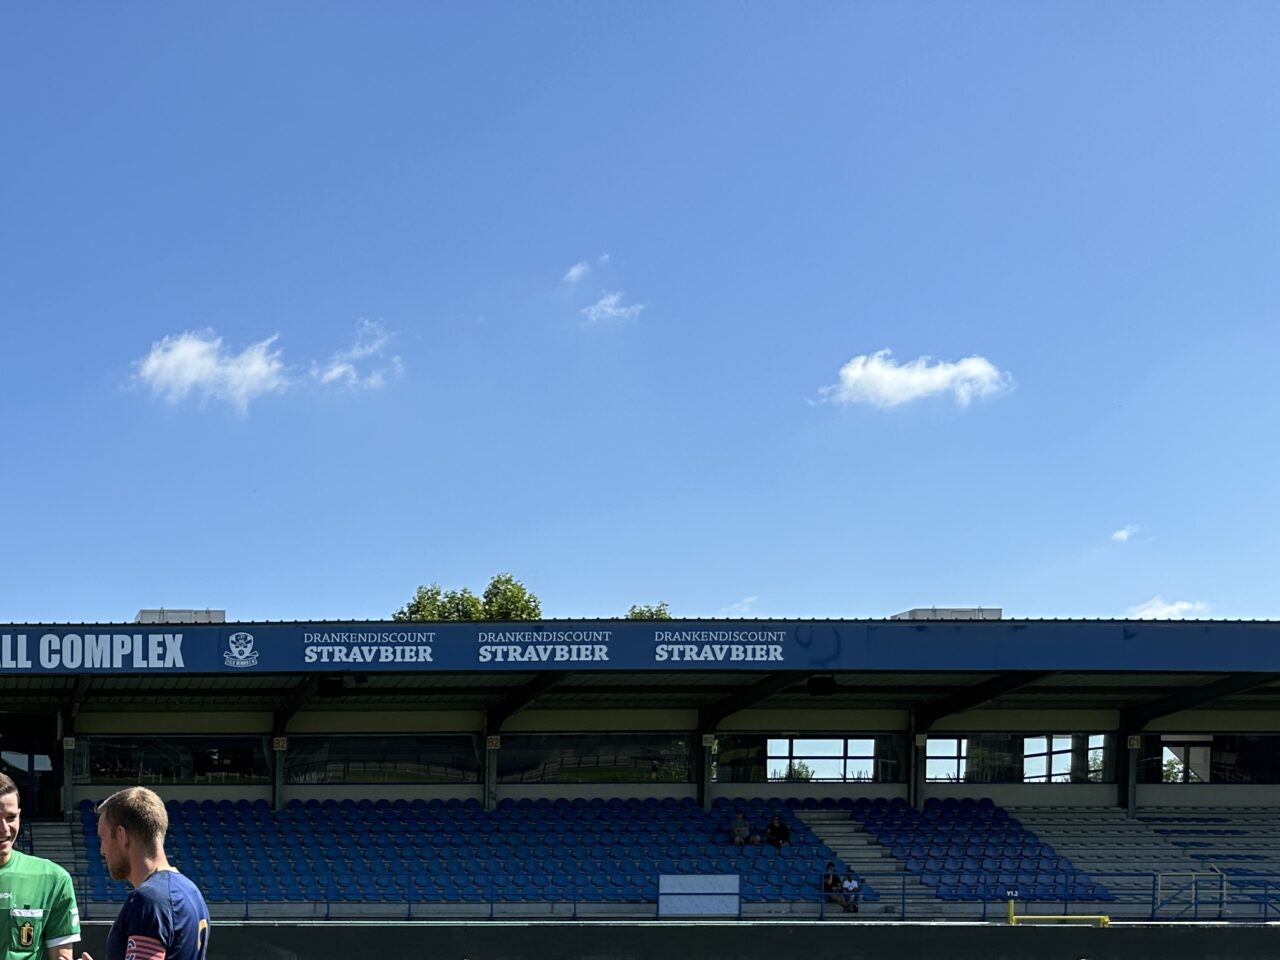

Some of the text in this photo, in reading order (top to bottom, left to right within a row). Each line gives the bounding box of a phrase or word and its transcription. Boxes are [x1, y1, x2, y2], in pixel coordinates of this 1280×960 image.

[304, 632, 436, 642] DRANKENDISCOUNT
[478, 631, 612, 642] DRANKENDISCOUNT
[654, 631, 786, 641] DRANKENDISCOUNT
[39, 634, 185, 669] COMPLEX
[306, 646, 433, 662] STRAVBIER
[480, 645, 610, 661] STRAVBIER
[656, 644, 784, 660] STRAVBIER
[275, 738, 286, 749] B2
[488, 737, 499, 748] B2
